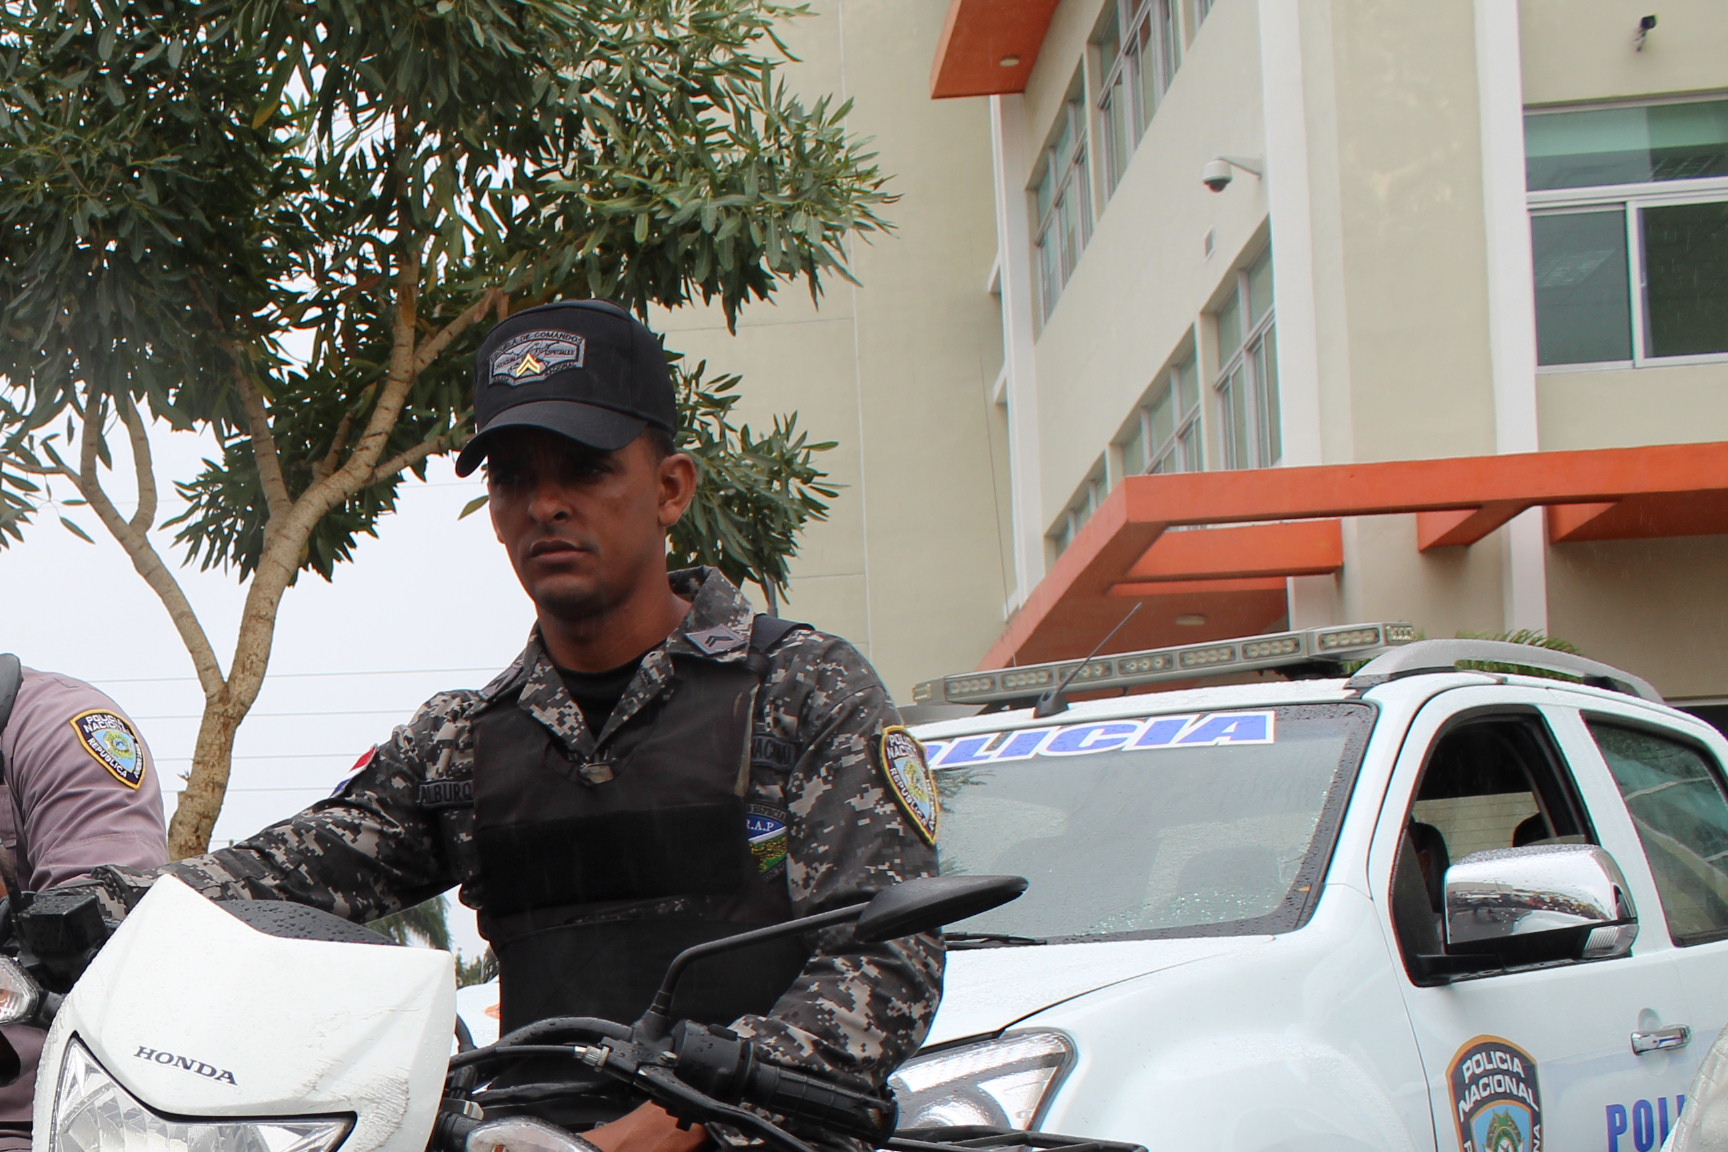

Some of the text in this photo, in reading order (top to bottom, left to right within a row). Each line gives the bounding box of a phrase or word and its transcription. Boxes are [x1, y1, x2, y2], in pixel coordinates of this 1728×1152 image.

[924, 711, 1275, 770] LICIA
[133, 1045, 238, 1086] HONDA
[1462, 1051, 1525, 1084] POLICIA
[1458, 1074, 1540, 1123] NACIONAL
